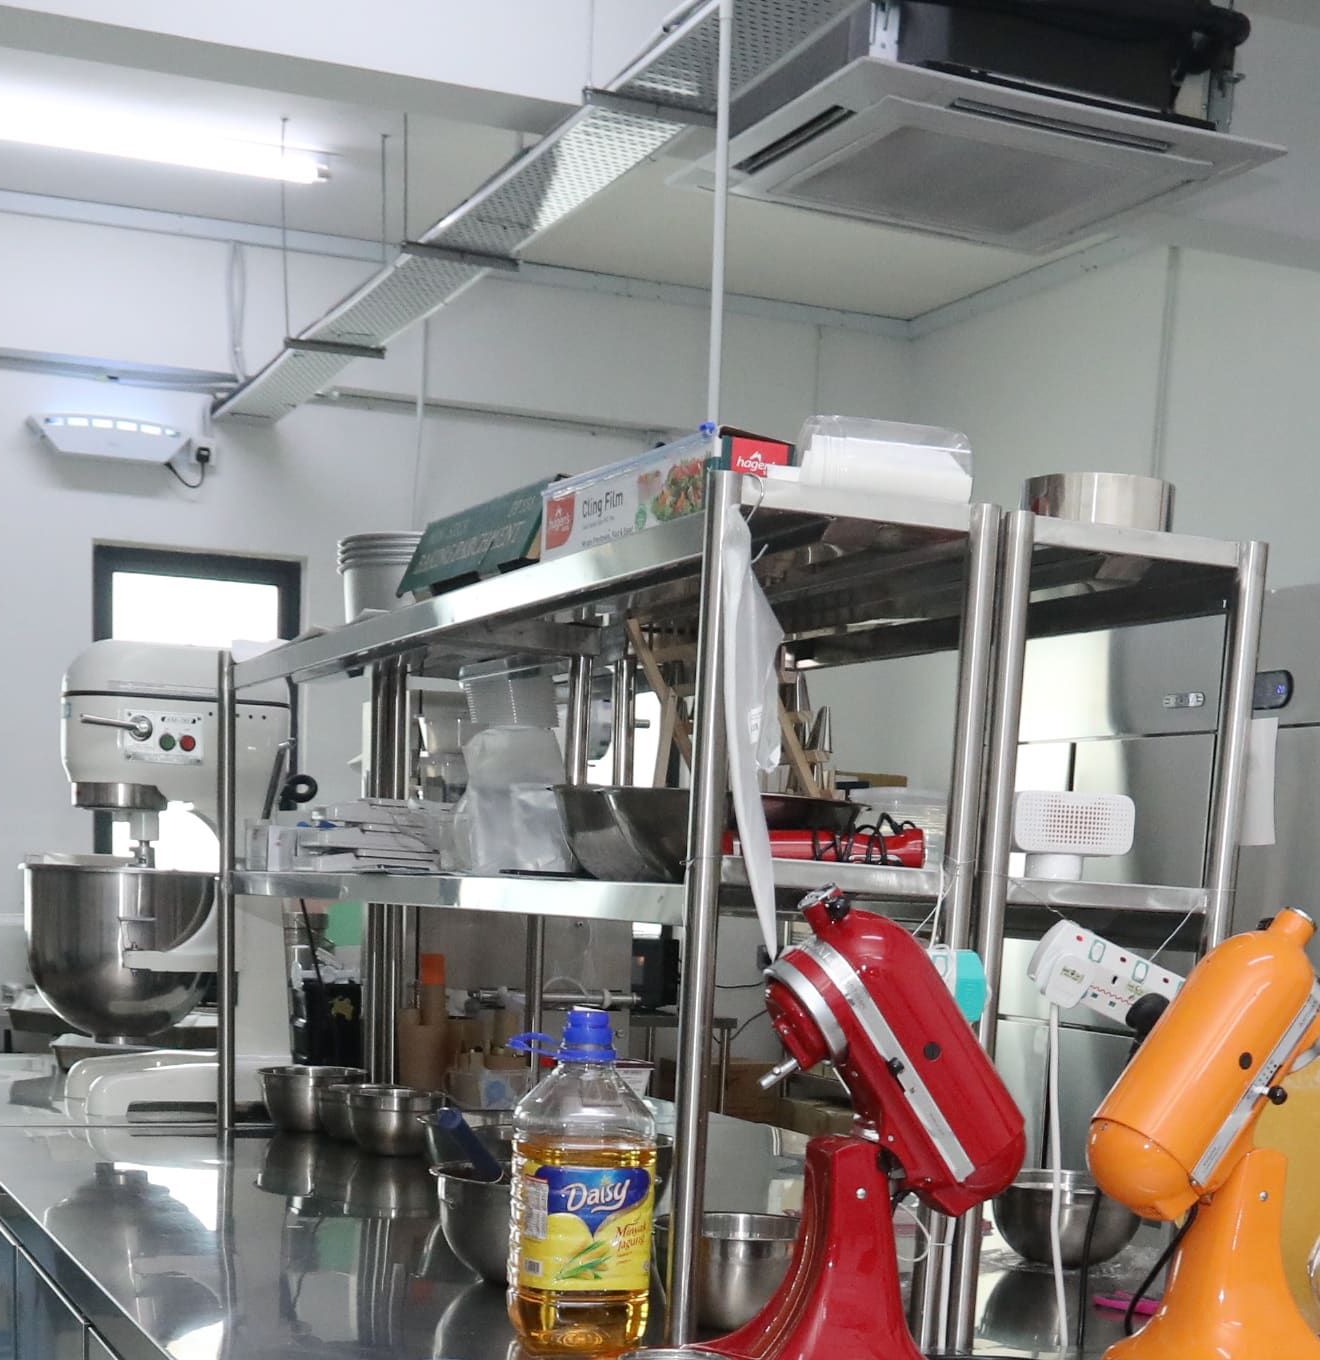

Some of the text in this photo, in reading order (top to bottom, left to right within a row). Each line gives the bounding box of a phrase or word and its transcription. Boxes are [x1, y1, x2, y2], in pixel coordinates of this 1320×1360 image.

[582, 491, 623, 518] Cling Film
[562, 1179, 631, 1214] Daisy
